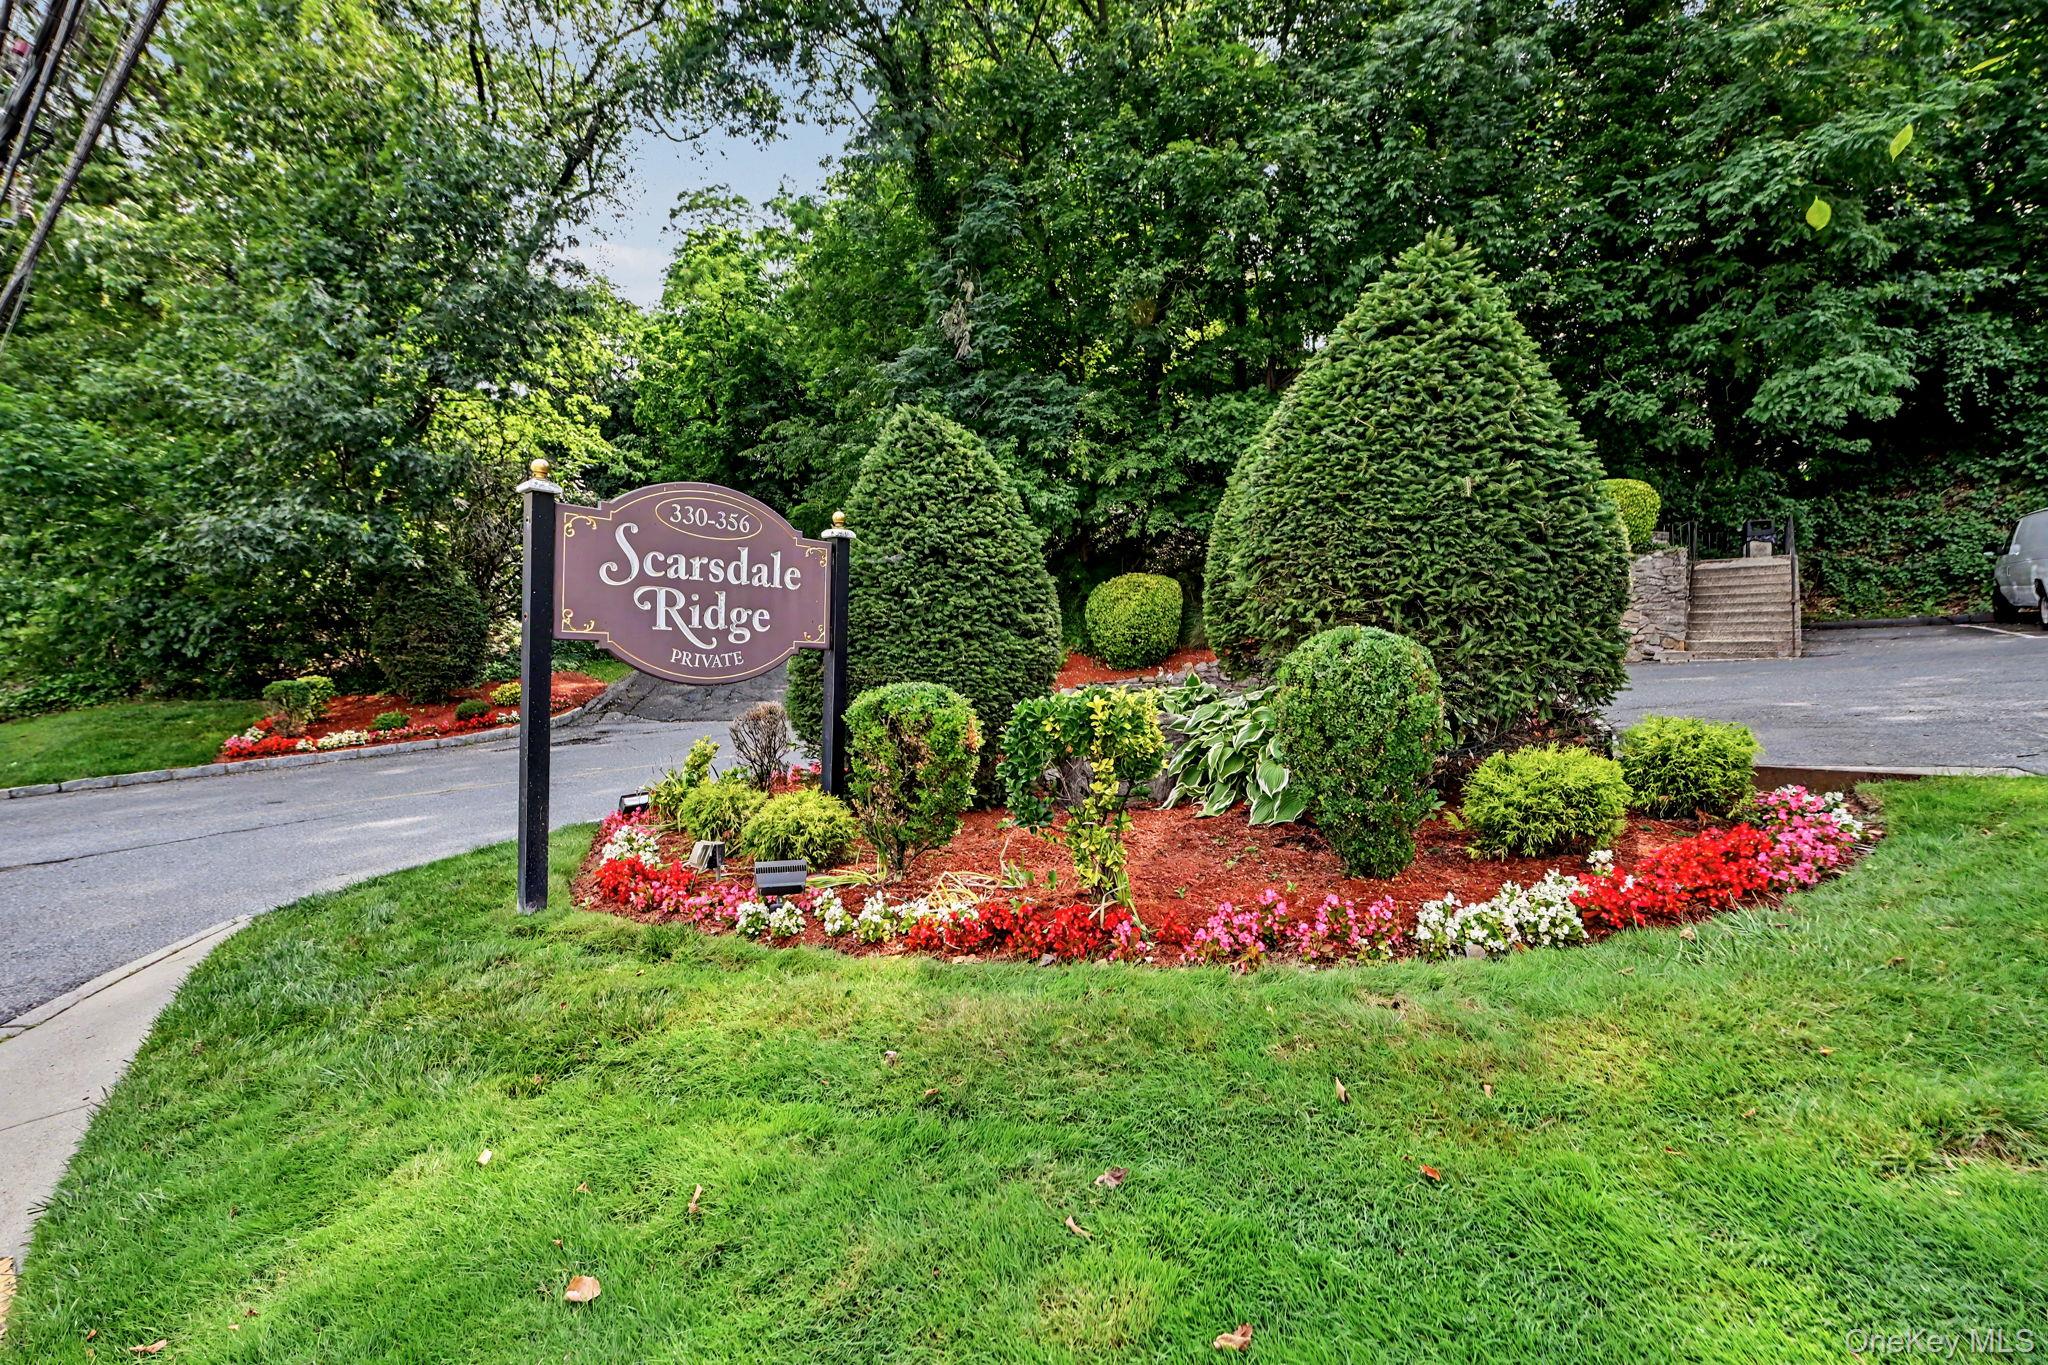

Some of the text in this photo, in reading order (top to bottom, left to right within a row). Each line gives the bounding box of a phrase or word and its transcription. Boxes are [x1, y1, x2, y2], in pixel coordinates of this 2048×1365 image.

[669, 503, 750, 533] 330-356
[599, 522, 801, 590] Scarsdale
[633, 585, 771, 649] Ridge
[670, 648, 744, 668] PRIVATE
